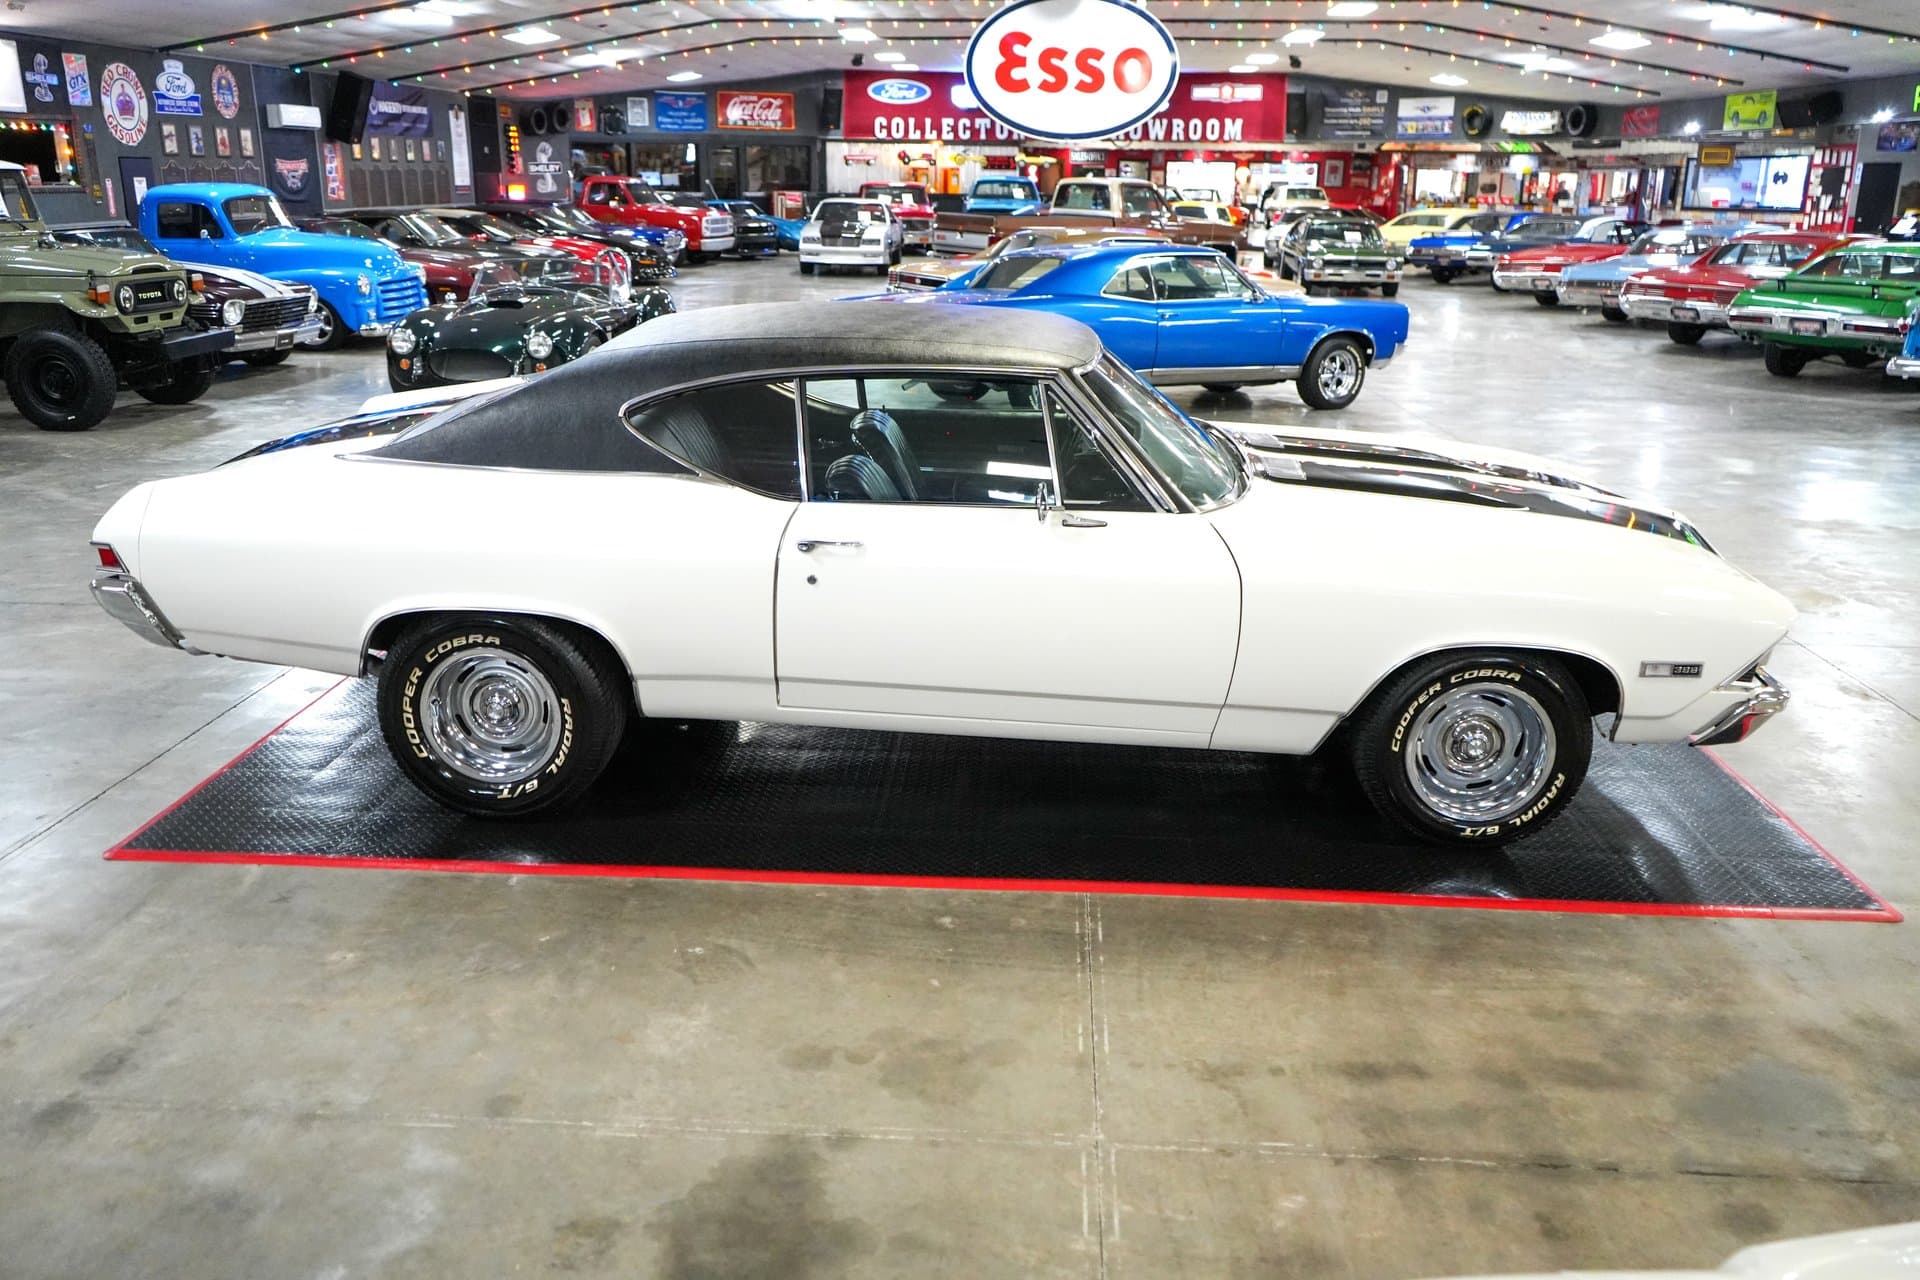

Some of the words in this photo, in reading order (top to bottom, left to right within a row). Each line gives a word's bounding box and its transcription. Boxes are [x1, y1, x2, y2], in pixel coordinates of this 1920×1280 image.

[102, 69, 114, 97] RED
[165, 75, 187, 94] Ford
[879, 83, 918, 100] Ford
[107, 114, 147, 144] GASOLINE
[138, 291, 162, 299] TOYOTA
[403, 667, 429, 759] COOPER
[425, 634, 500, 664] COBRA
[1391, 682, 1443, 753] COOPER
[1450, 668, 1522, 684] COBRA
[546, 697, 574, 775] RADIAL
[497, 779, 539, 800] G/T
[1509, 773, 1566, 827] RADIAL
[1460, 825, 1500, 837] G/T
